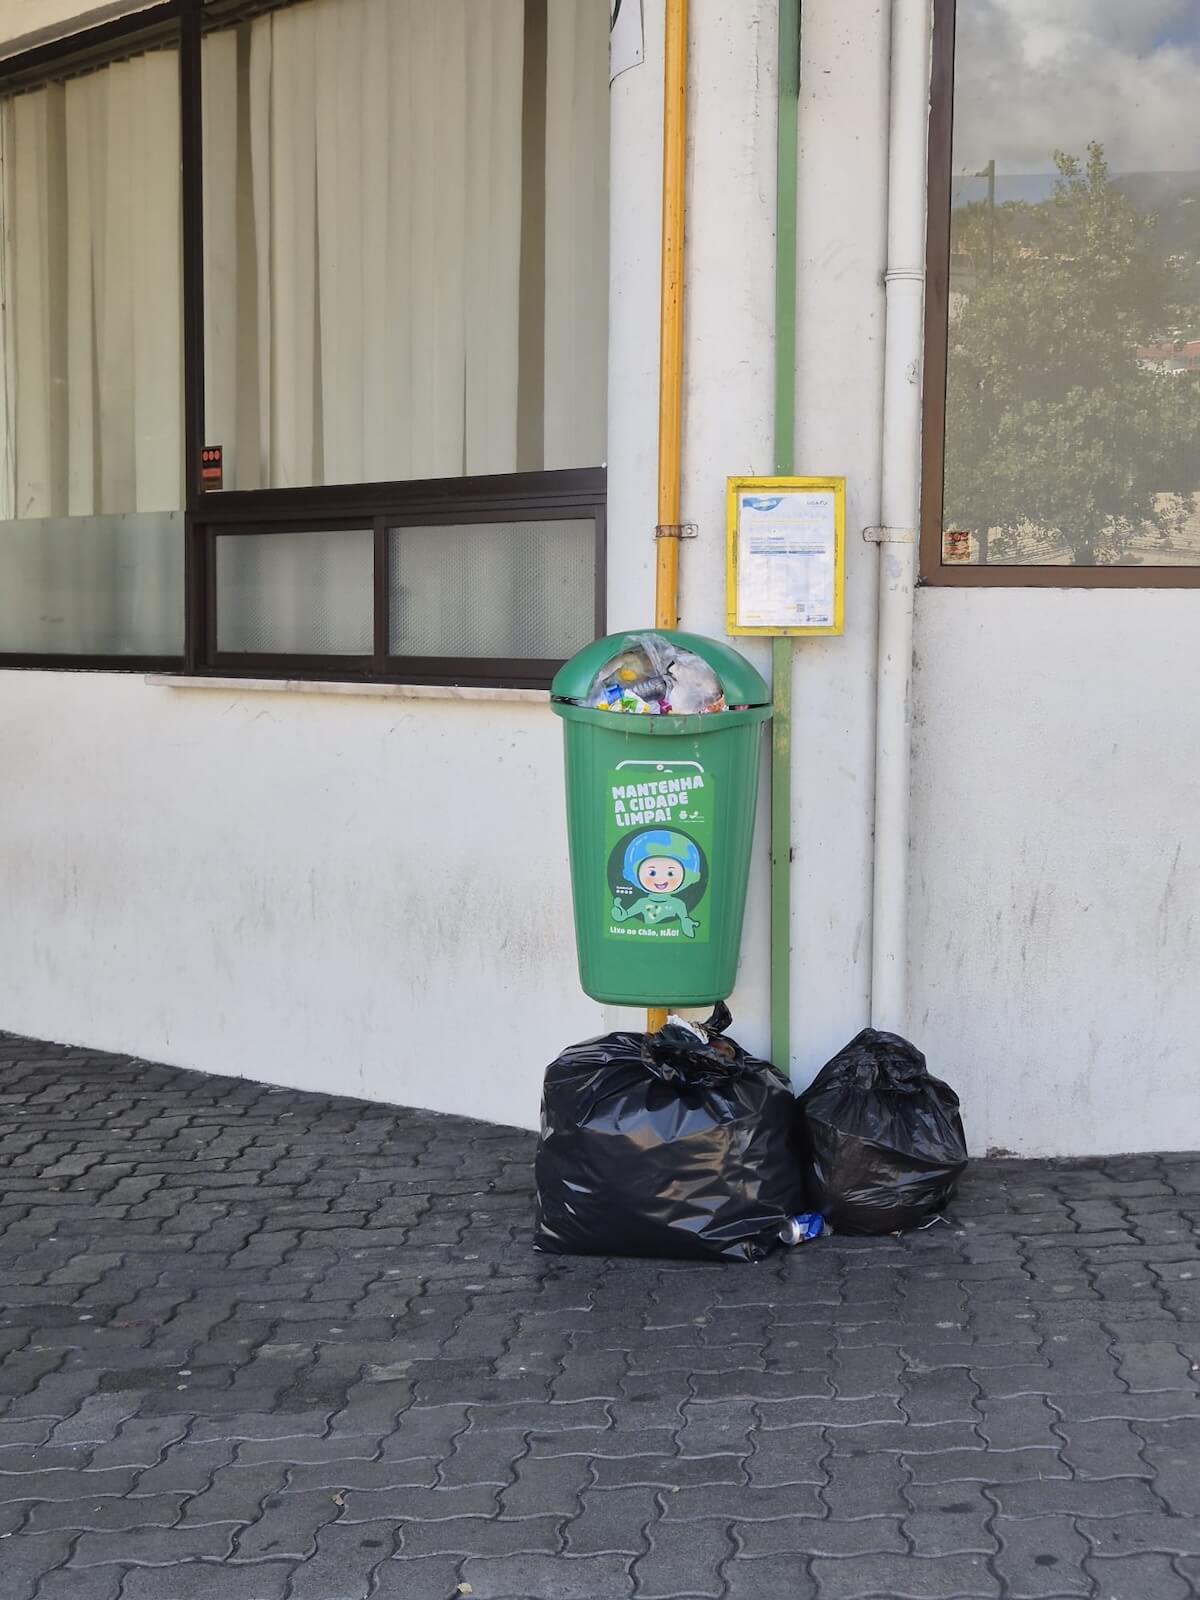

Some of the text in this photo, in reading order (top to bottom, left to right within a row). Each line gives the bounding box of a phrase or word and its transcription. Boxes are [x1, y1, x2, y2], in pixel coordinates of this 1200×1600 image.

[612, 776, 704, 799] MANTENHA
[614, 792, 688, 813] A CIDADE
[615, 807, 671, 826] LIMPA!
